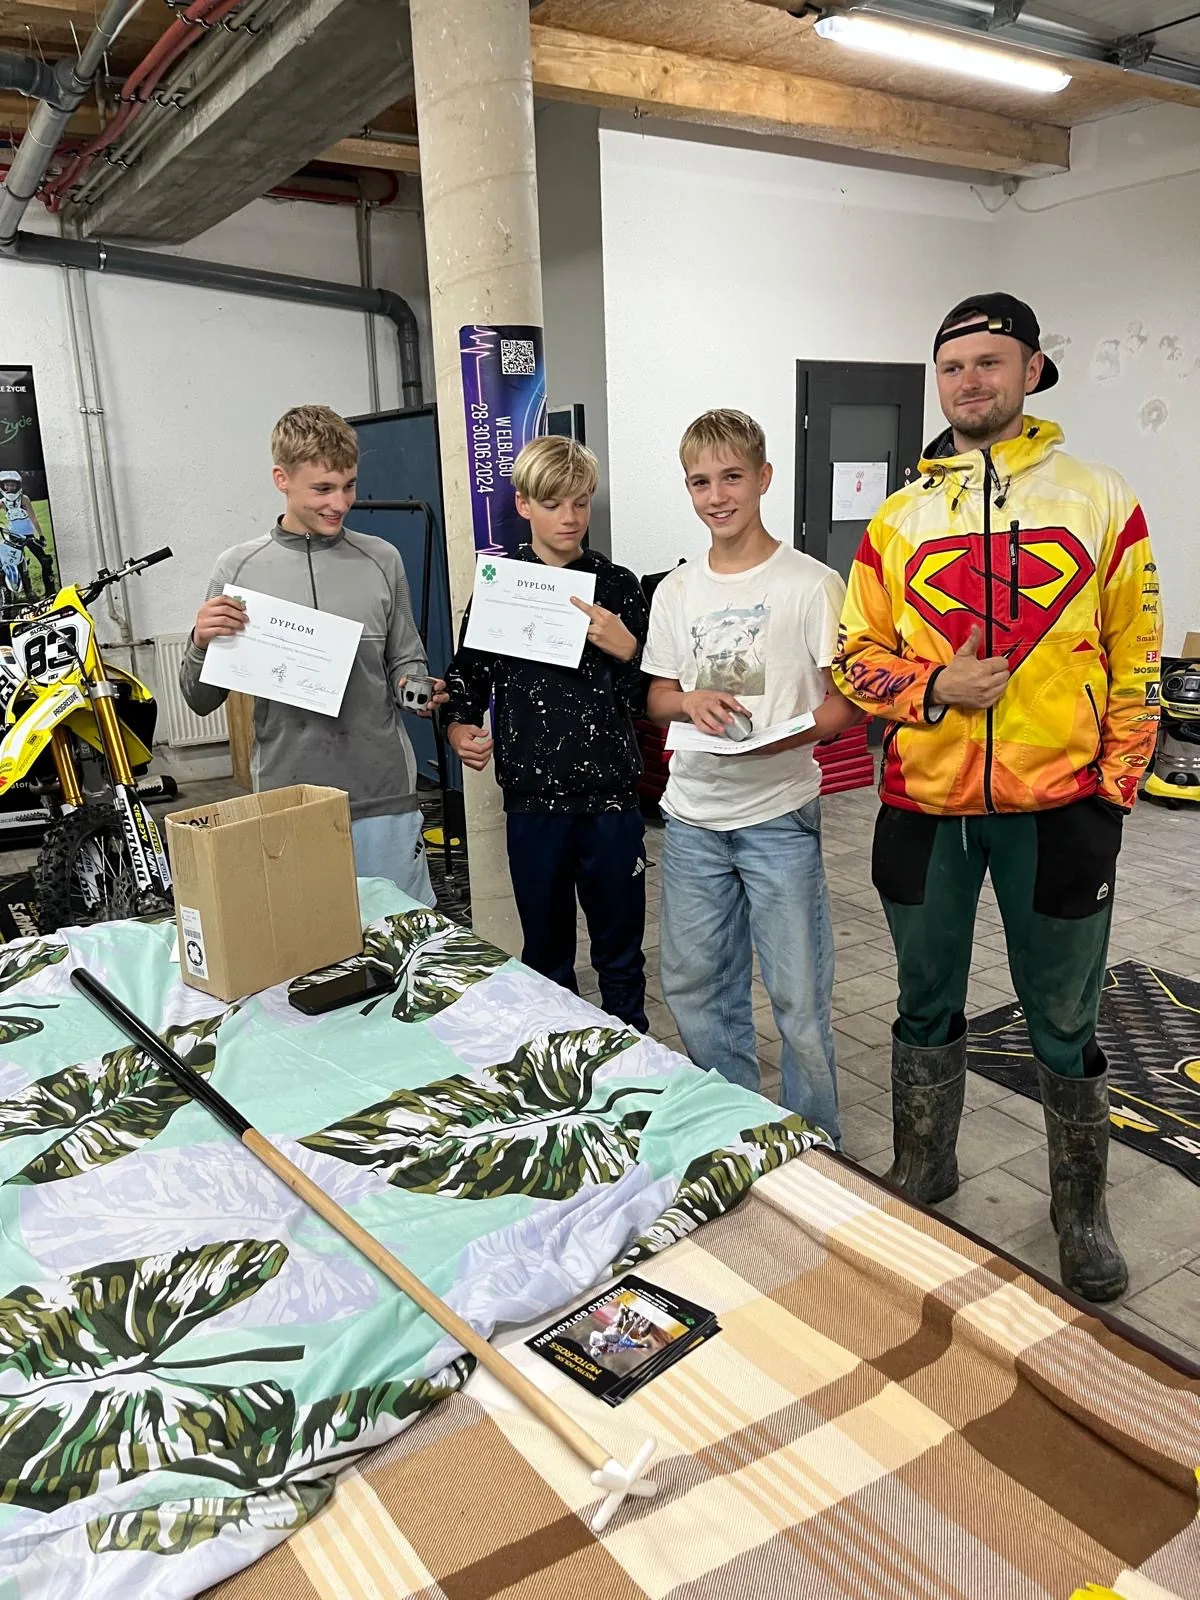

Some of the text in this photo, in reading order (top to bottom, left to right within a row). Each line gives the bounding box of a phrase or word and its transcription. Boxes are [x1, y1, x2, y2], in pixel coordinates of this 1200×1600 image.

[6, 385, 27, 393] ŻYCIE
[0, 416, 32, 442] Życie
[470, 403, 494, 494] 28-30.06.2024
[495, 416, 514, 477] W ELBLĄGU
[516, 579, 556, 592] DYPLOM
[269, 616, 315, 636] DYPLOM
[24, 626, 79, 680] 83
[588, 1286, 626, 1314] MIESZKO
[533, 1310, 589, 1347] GOTKOWSKI
[548, 1340, 602, 1375] MOTOCROSS
